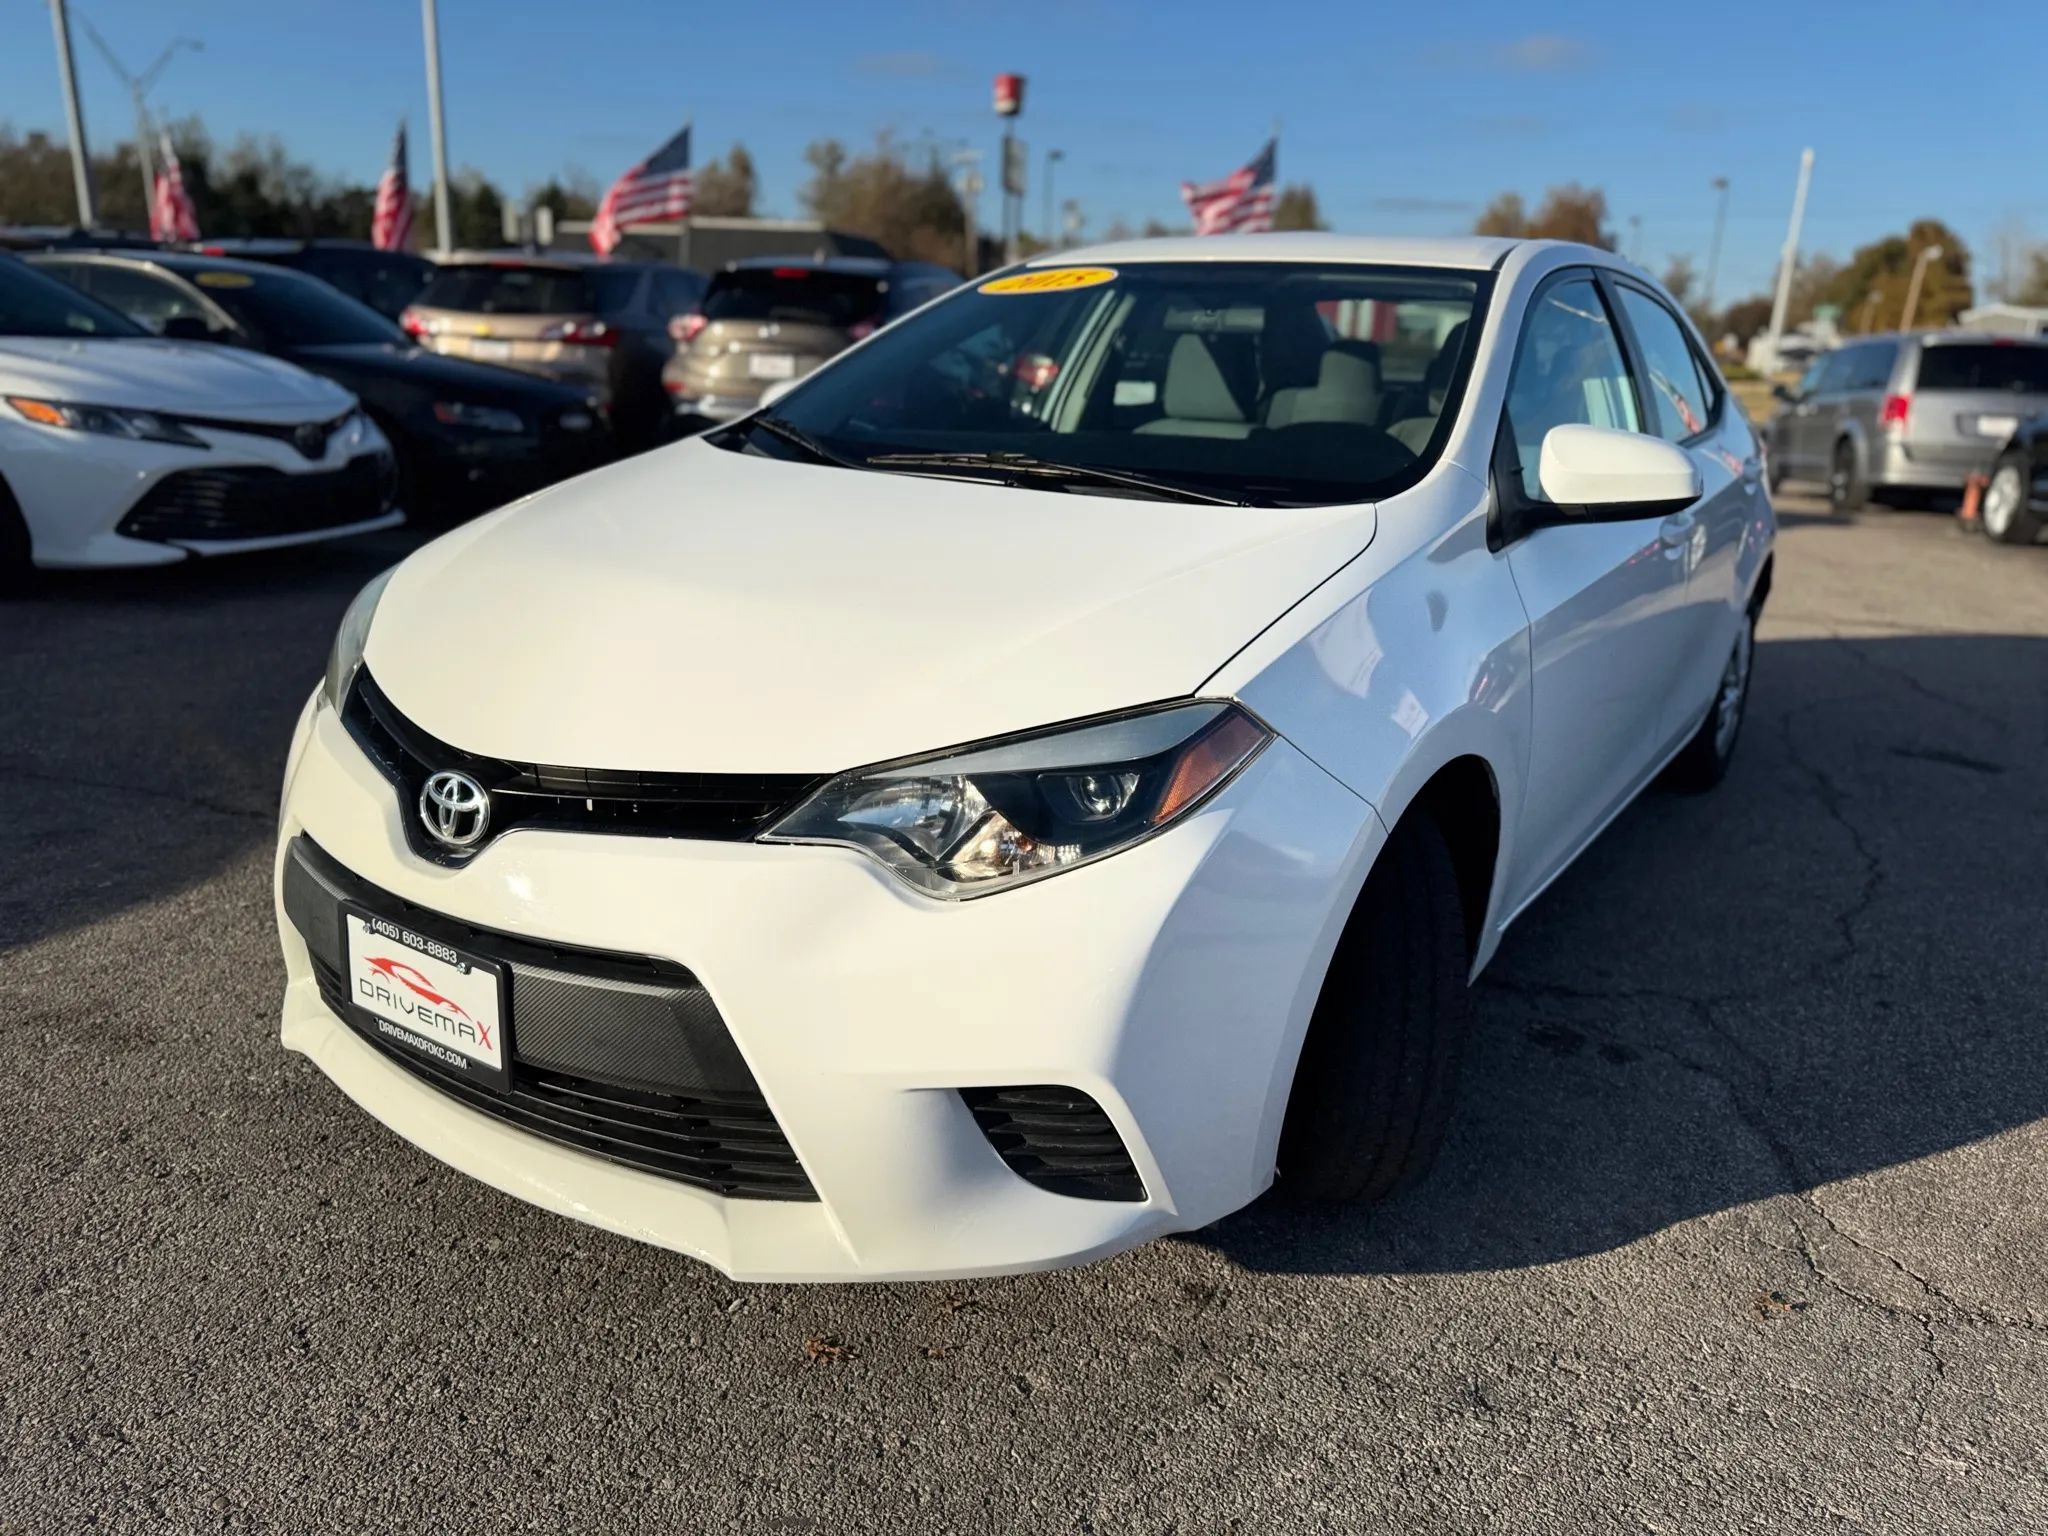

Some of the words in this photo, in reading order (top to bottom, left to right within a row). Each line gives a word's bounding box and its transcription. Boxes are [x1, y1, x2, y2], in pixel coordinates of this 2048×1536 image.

[371, 918, 400, 940] (405)
[402, 931, 458, 963] 603-8883
[378, 1019, 467, 1070] DRIVEMAXOFOKC.COM
